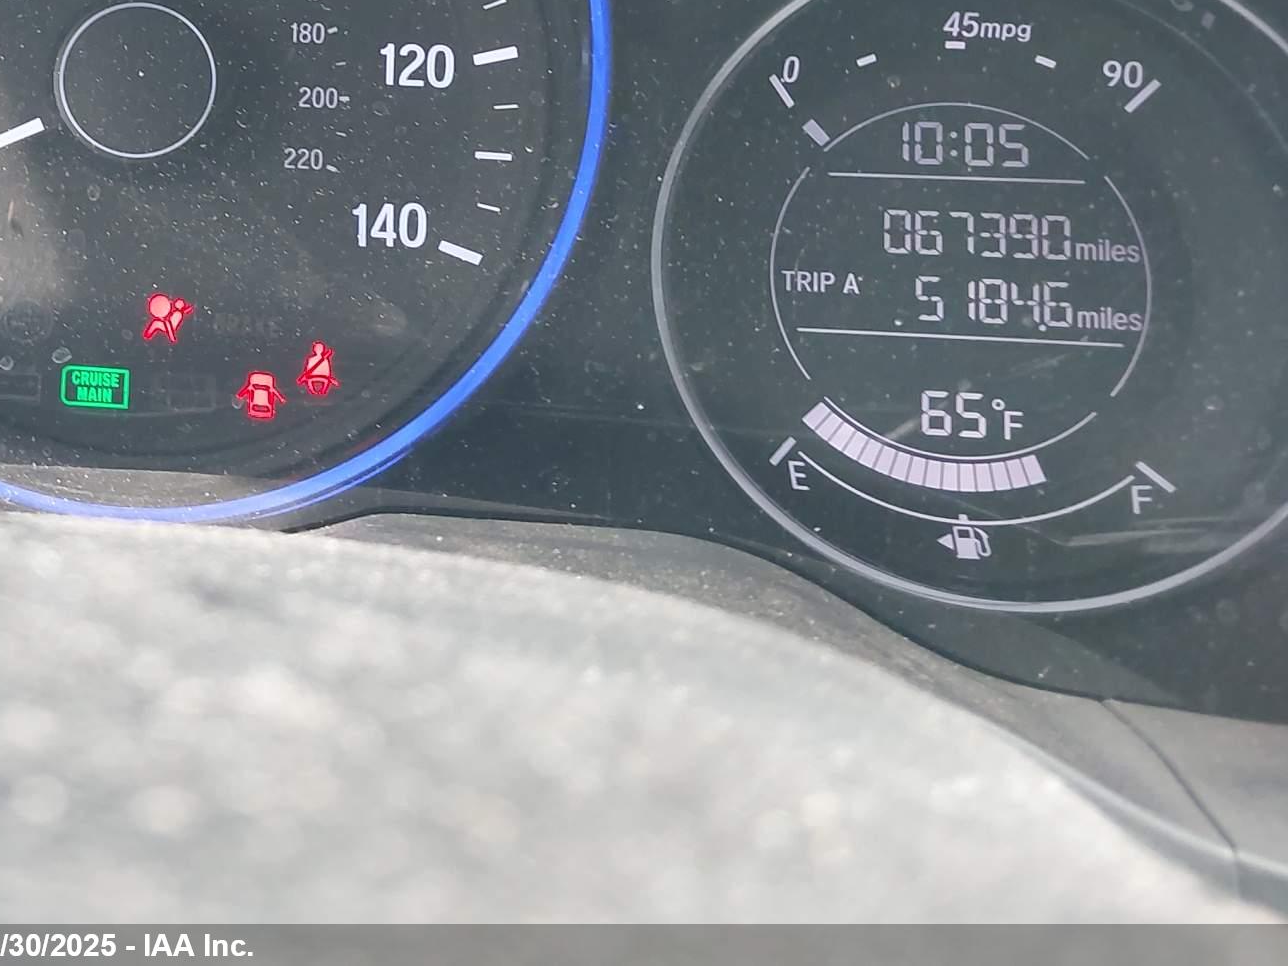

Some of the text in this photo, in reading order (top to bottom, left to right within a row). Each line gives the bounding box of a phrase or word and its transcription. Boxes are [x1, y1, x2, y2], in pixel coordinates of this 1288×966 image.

[290, 22, 325, 44] 180
[380, 42, 455, 89] 120
[782, 56, 800, 83] 0
[1102, 60, 1143, 88] 90
[298, 86, 338, 109] 200
[284, 147, 323, 171] 220
[902, 121, 1030, 168] 10:05
[352, 202, 427, 248] 140
[883, 209, 1142, 263] 067390 miles
[781, 270, 836, 293] TRIP
[842, 275, 862, 294] A
[1077, 306, 1146, 334] miles
[71, 369, 123, 388] CRUISE
[74, 383, 115, 405] MAIN
[788, 458, 813, 491] E
[1131, 485, 1153, 515] F
